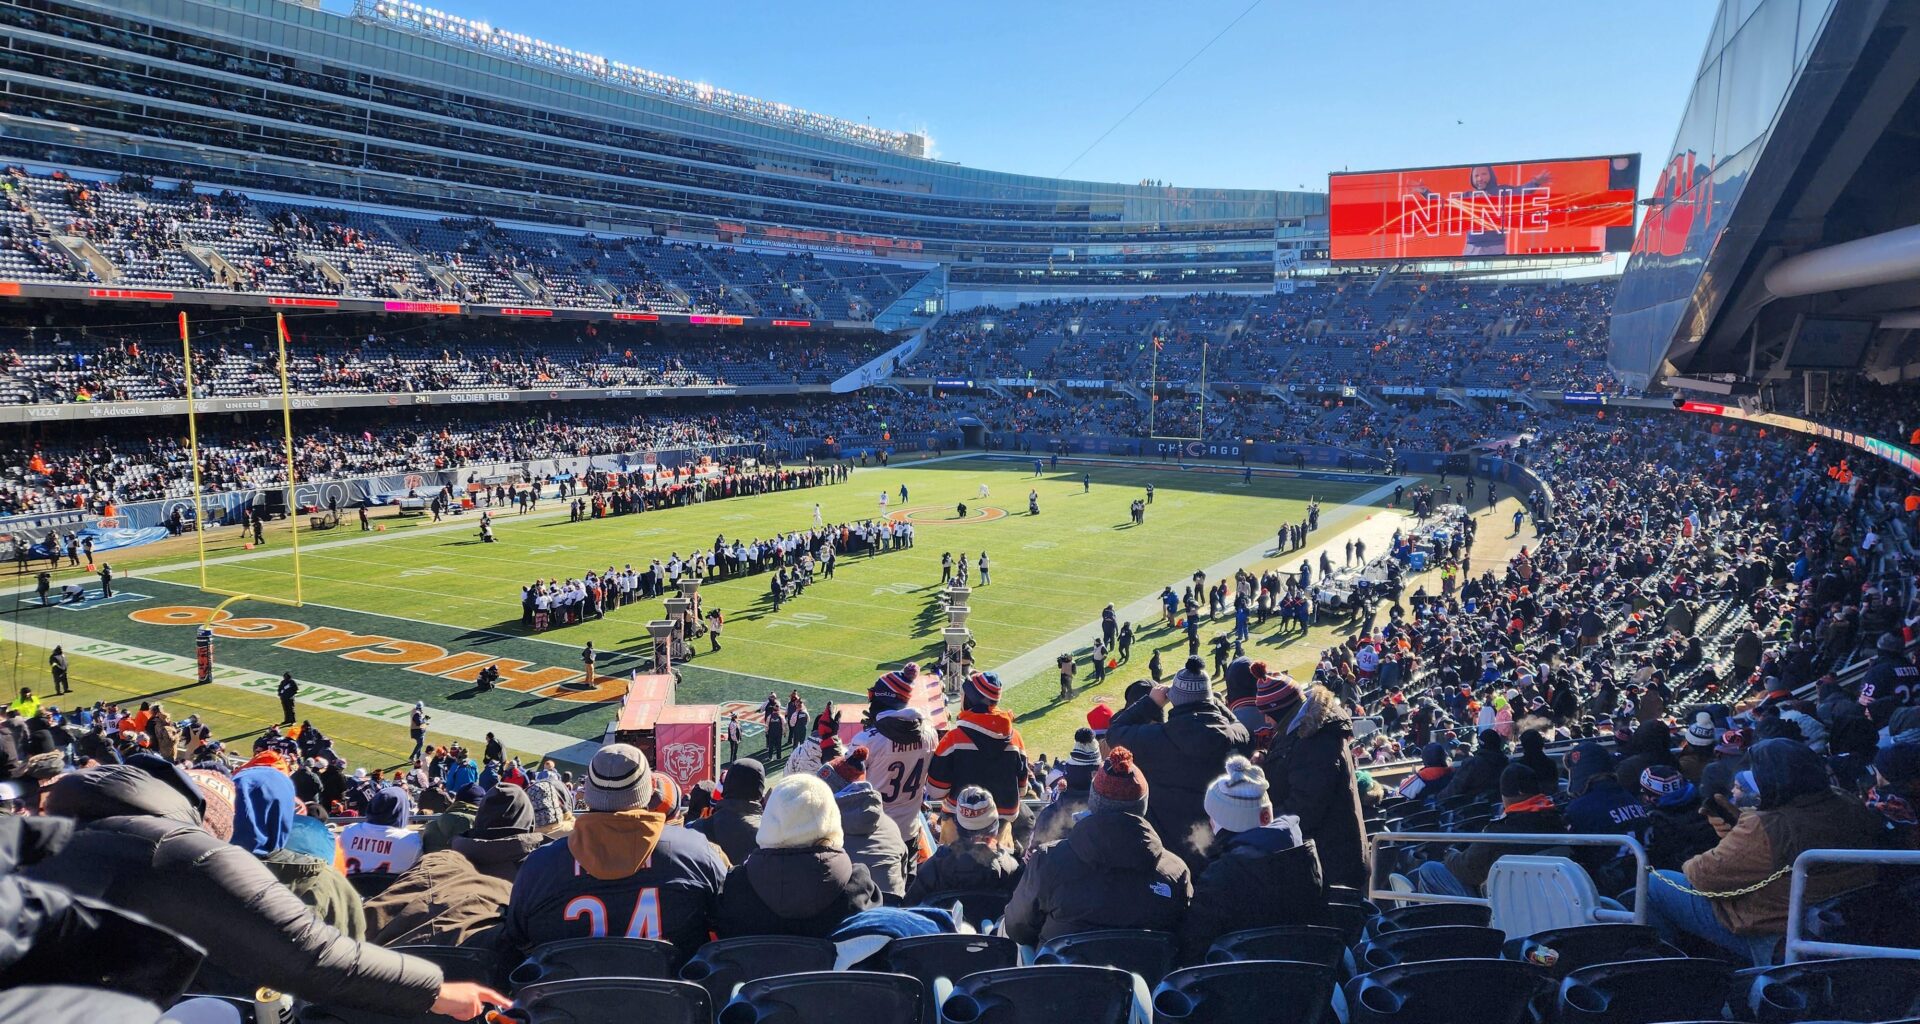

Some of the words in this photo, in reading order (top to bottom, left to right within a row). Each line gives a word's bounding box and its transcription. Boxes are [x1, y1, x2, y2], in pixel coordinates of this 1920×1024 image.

[1402, 187, 1550, 238] NINE
[999, 378, 1037, 386] BEAR
[1067, 380, 1105, 388] DOWN
[450, 393, 485, 402] SOLDIER
[488, 392, 510, 401] FIELD
[1382, 387, 1425, 396] BEAR
[1465, 388, 1513, 398] DOWN
[300, 399, 319, 407] PNC
[28, 407, 61, 417] VIZZY
[103, 406, 145, 417] Advocate
[128, 604, 632, 703] CHICAGO
[240, 676, 368, 708] TAKS
[881, 758, 925, 803] 34
[351, 836, 393, 855] PAYTON
